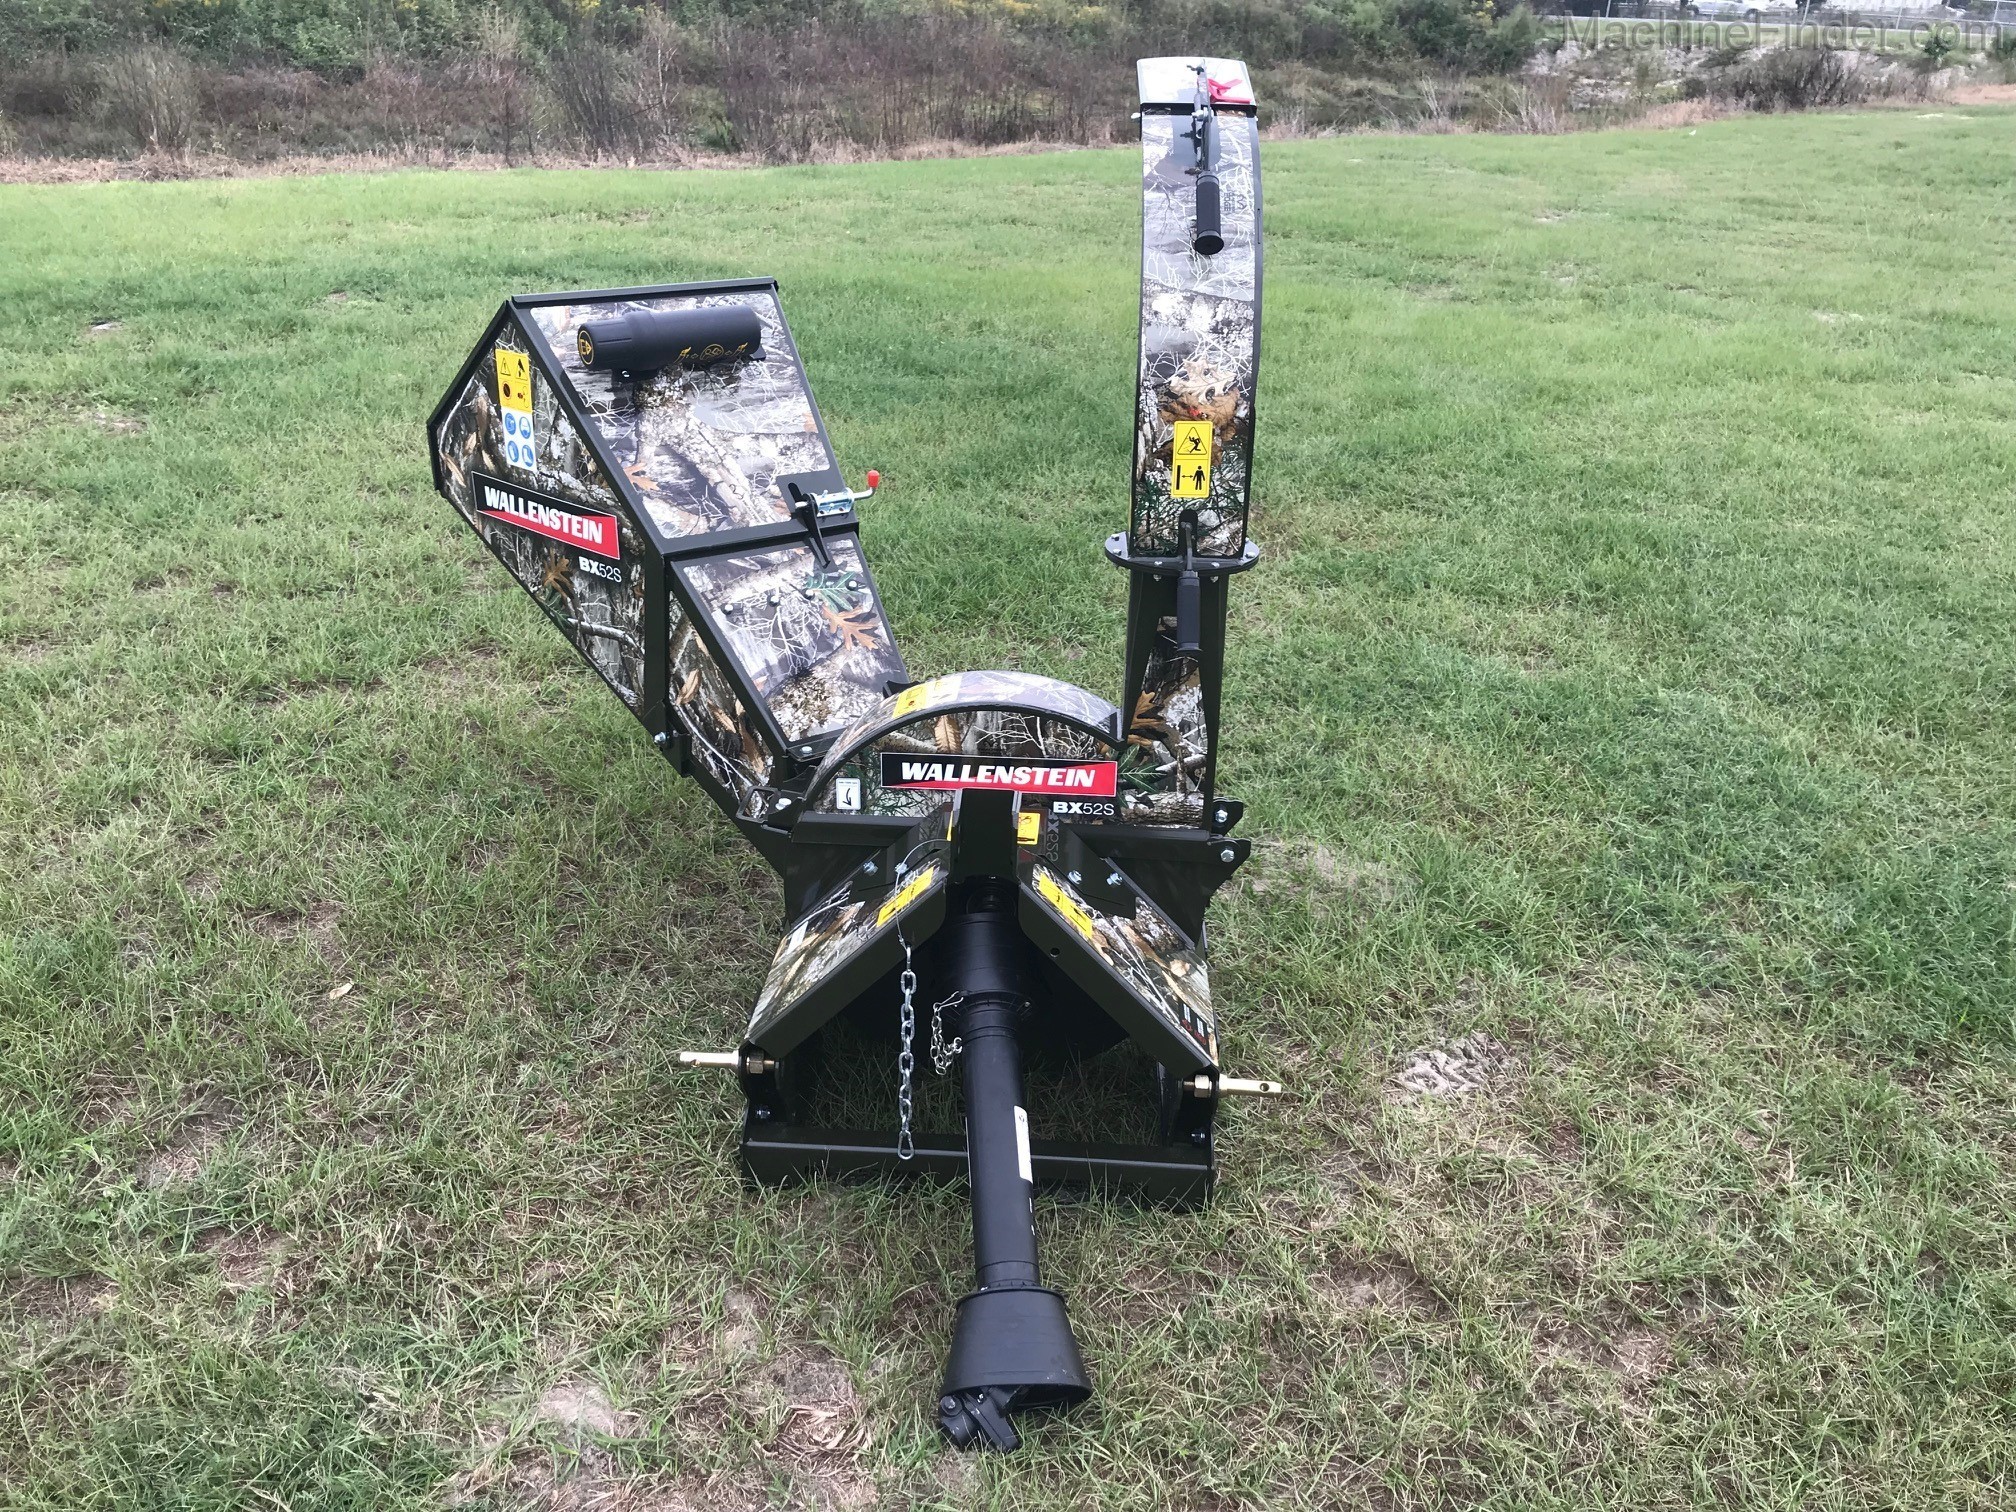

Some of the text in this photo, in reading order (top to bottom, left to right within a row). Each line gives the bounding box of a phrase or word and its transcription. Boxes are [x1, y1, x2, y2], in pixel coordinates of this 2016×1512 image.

[484, 485, 602, 545] WALLENSTEIN
[579, 556, 622, 583] BX52S
[902, 762, 1096, 788] WALLENSTEIN
[1053, 801, 1115, 816] BX52S
